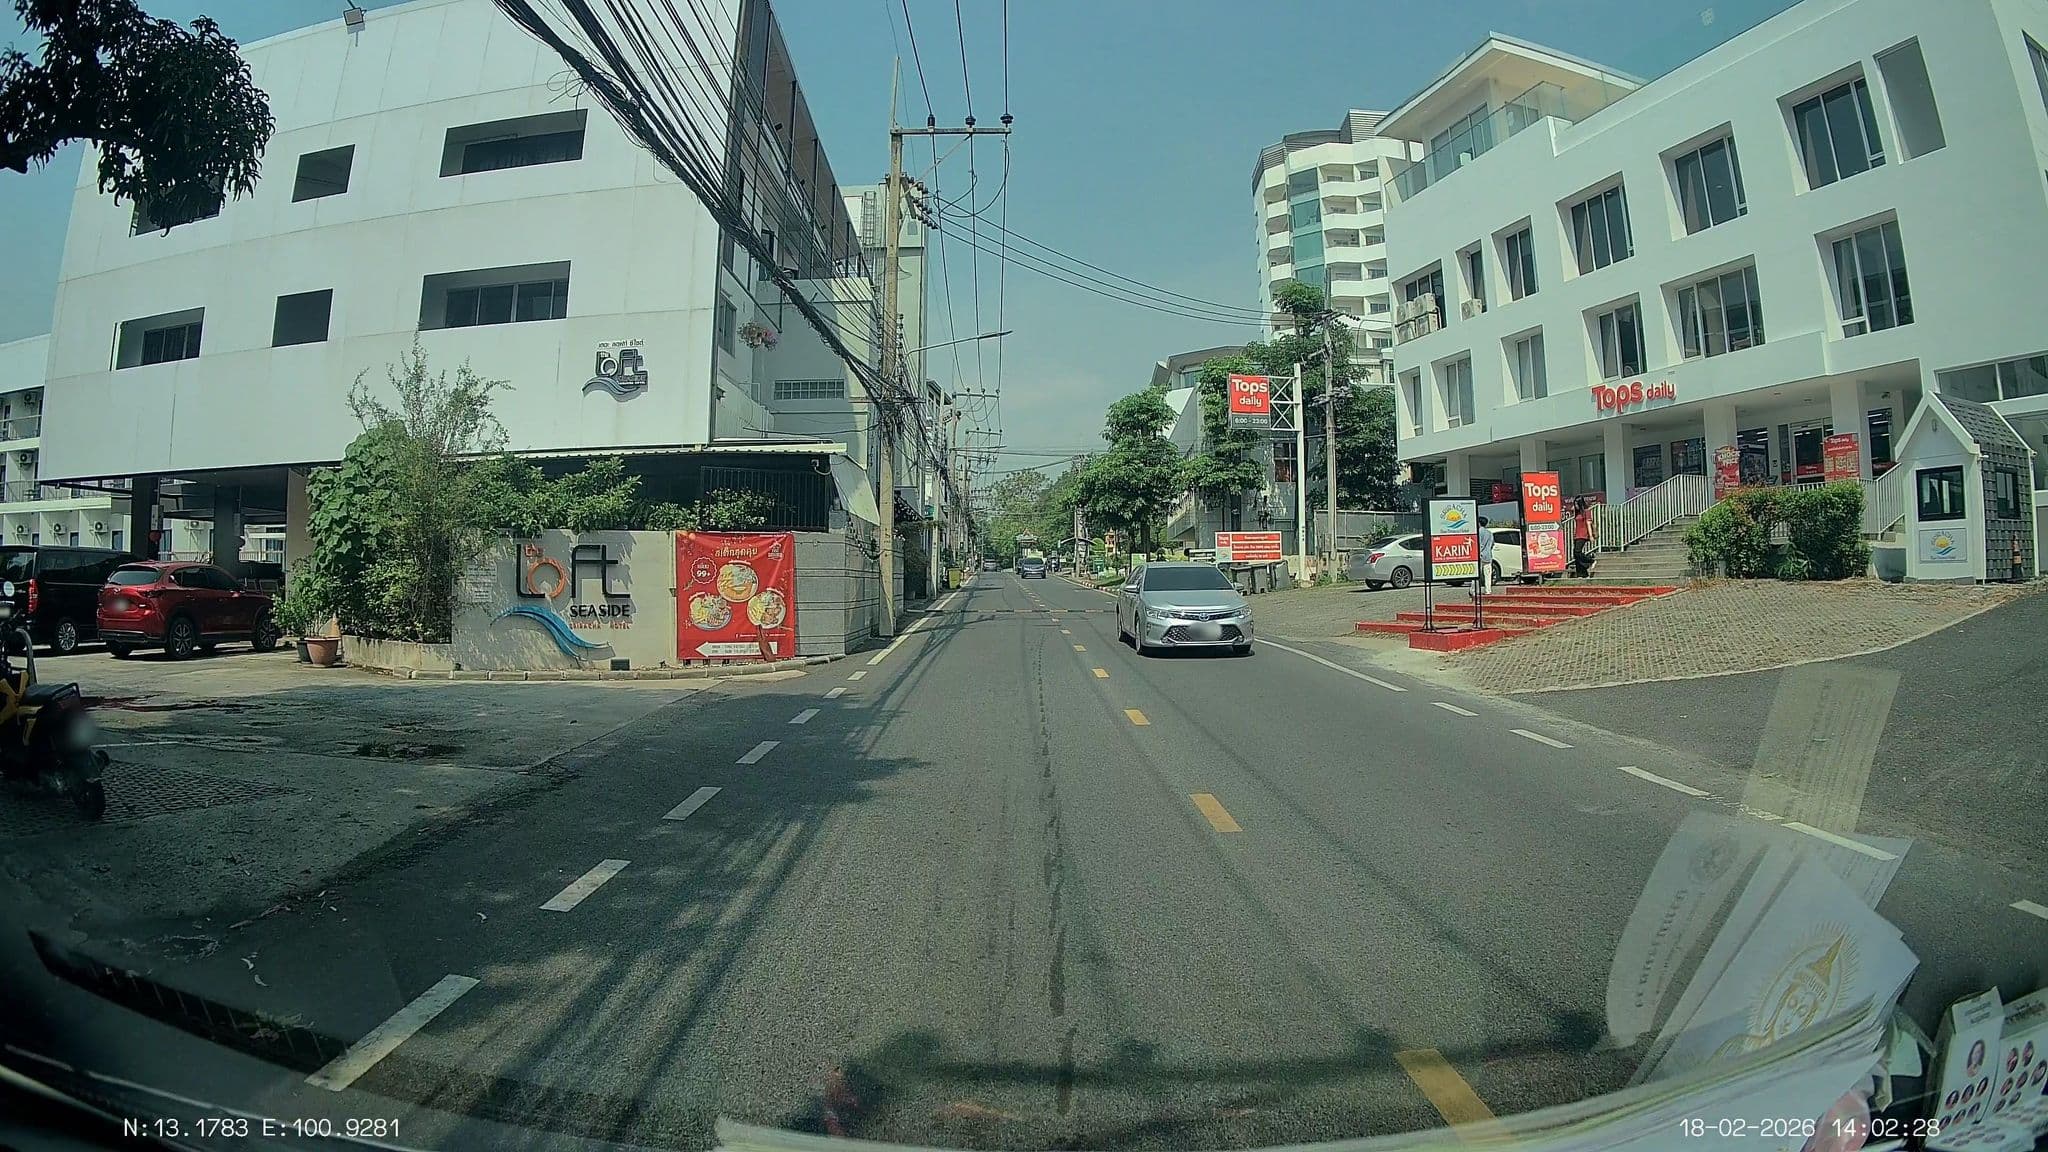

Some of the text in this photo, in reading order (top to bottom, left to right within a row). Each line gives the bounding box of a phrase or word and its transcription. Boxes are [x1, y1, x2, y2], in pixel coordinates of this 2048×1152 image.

[1231, 379, 1268, 395] Tops
[1239, 396, 1262, 407] daily
[1592, 381, 1676, 413] Tops daily
[1524, 483, 1558, 499] Tops
[1532, 503, 1553, 513] daily
[1435, 545, 1470, 558] KARIN
[569, 604, 631, 618] SEASIDE
